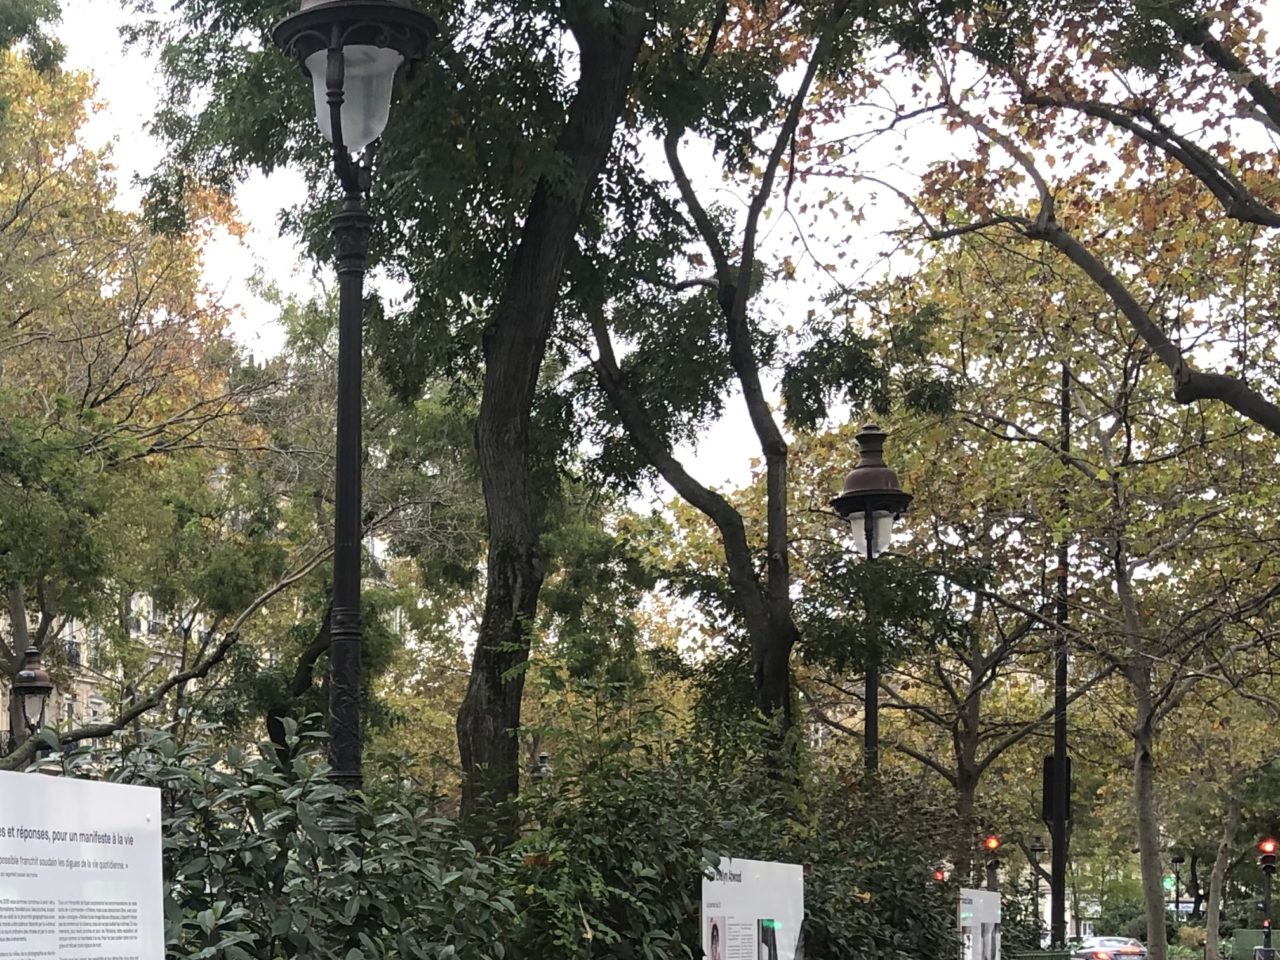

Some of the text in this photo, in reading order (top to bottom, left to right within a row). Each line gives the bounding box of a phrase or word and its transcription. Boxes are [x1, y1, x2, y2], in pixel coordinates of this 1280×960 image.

[7, 826, 15, 838] et
[16, 825, 51, 842] réponses,
[52, 830, 68, 843] pour
[70, 831, 78, 842] un
[79, 830, 111, 844] manifeste
[112, 832, 117, 844] à
[118, 832, 123, 845] la
[124, 833, 134, 846] vie
[39, 857, 57, 867] soudain
[81, 859, 86, 868] de
[87, 859, 91, 868] la
